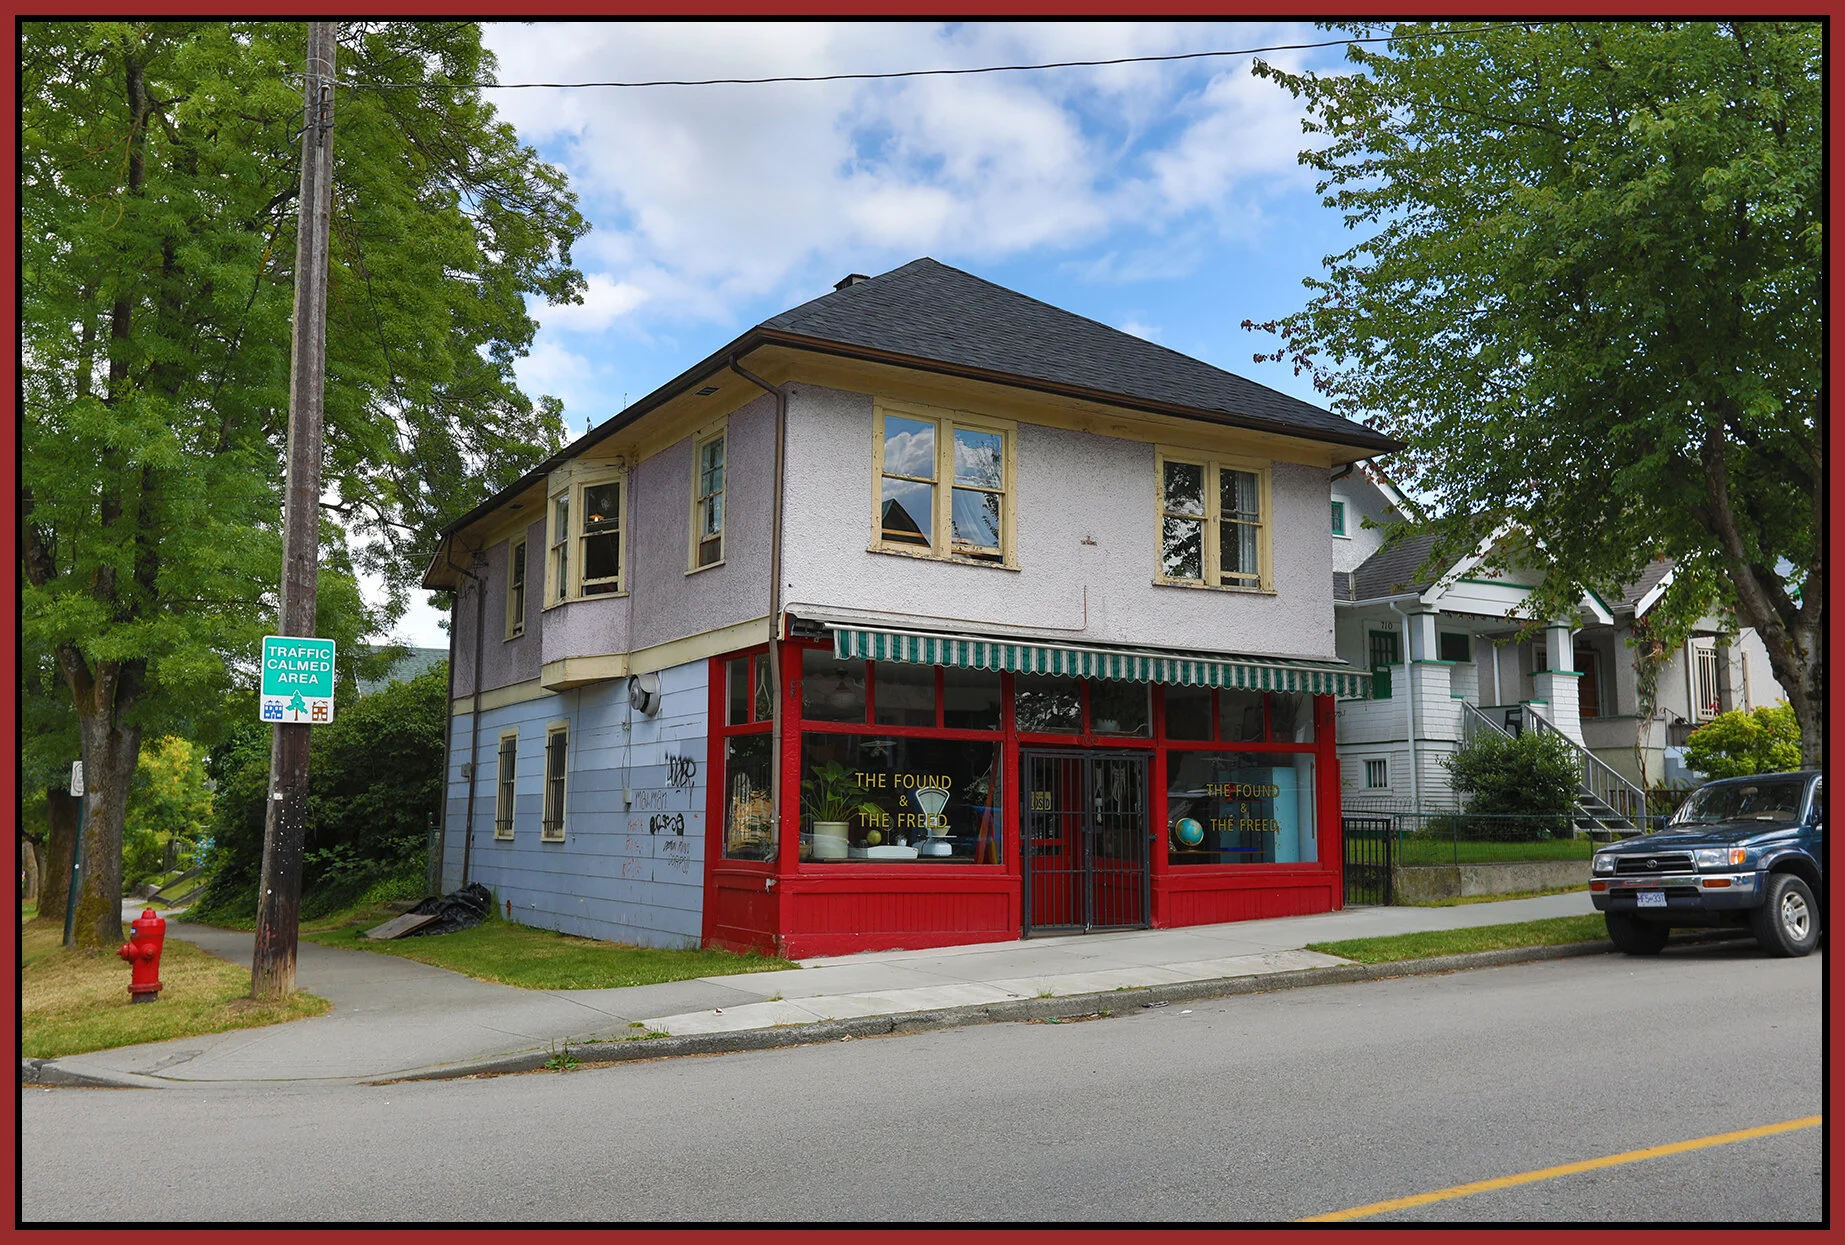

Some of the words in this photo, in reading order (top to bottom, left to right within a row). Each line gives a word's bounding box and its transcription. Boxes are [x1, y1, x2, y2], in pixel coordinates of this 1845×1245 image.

[1381, 621, 1392, 630] 710
[268, 646, 330, 659] TRAFFIC
[267, 659, 330, 672] CALMED
[278, 673, 319, 684] AREA
[855, 772, 886, 788] THE
[894, 773, 952, 790] FOUND
[1206, 783, 1231, 797] THE
[1236, 784, 1281, 798] FOUND
[899, 795, 908, 807] &
[1240, 802, 1248, 813] &
[858, 813, 890, 828] THE
[897, 813, 948, 829] FREED
[1210, 818, 1234, 832] THE
[1239, 818, 1279, 832] FREED
